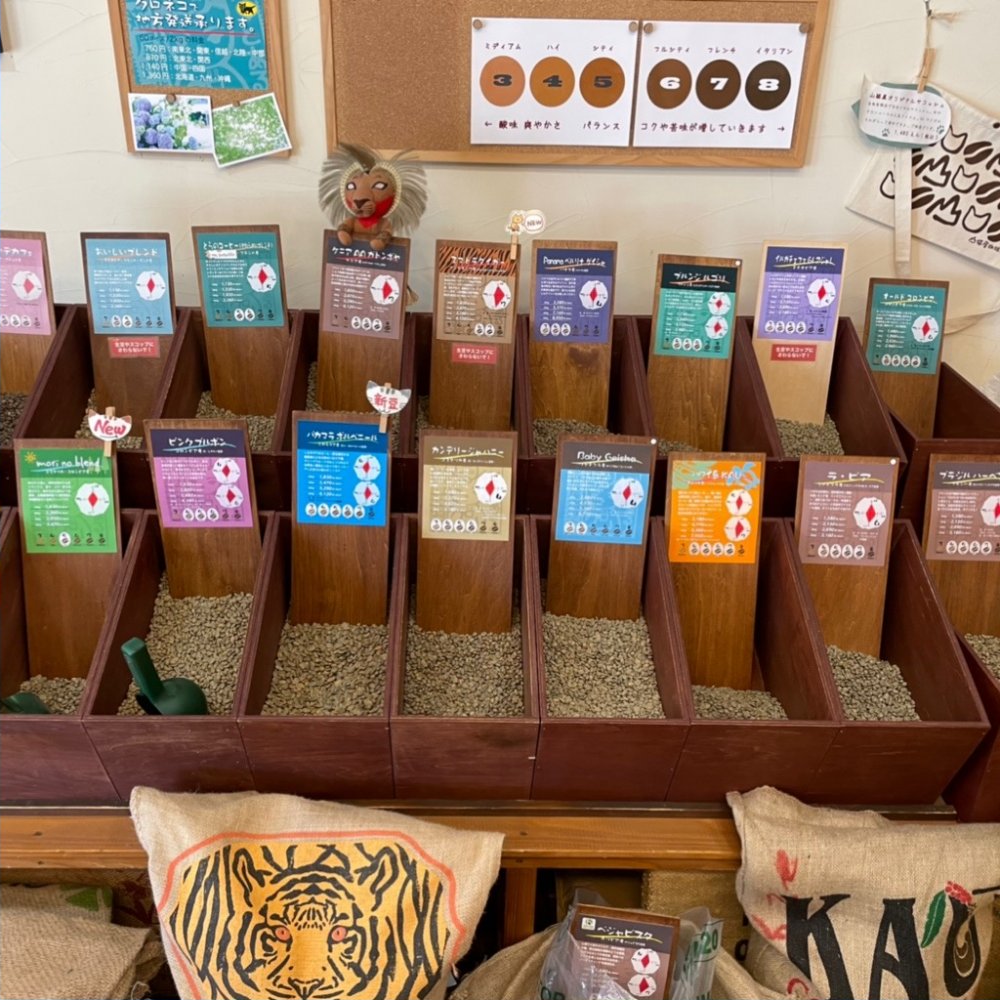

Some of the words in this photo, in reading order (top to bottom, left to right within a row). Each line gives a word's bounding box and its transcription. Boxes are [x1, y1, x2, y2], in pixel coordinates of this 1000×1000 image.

[135, 13, 255, 33] 地方発送承ります。
[485, 42, 521, 50] ミディアム
[756, 47, 793, 55] イタリアン
[493, 74, 512, 86] 3
[542, 75, 563, 87] 4
[594, 76, 613, 88] 5
[659, 76, 680, 89] 6
[710, 77, 729, 90] 7
[758, 78, 780, 91] 8
[499, 120, 518, 129] 酸味
[524, 120, 561, 129] 爽やかさ
[641, 123, 766, 133] コクや苦味が増していきます
[95, 247, 158, 257] おいしいブレンド
[374, 393, 399, 410] 新豆
[94, 419, 126, 436] New
[36, 459, 59, 467] mori
[74, 455, 100, 468] blend
[577, 451, 602, 461] Baby
[604, 452, 637, 462] Geisha
